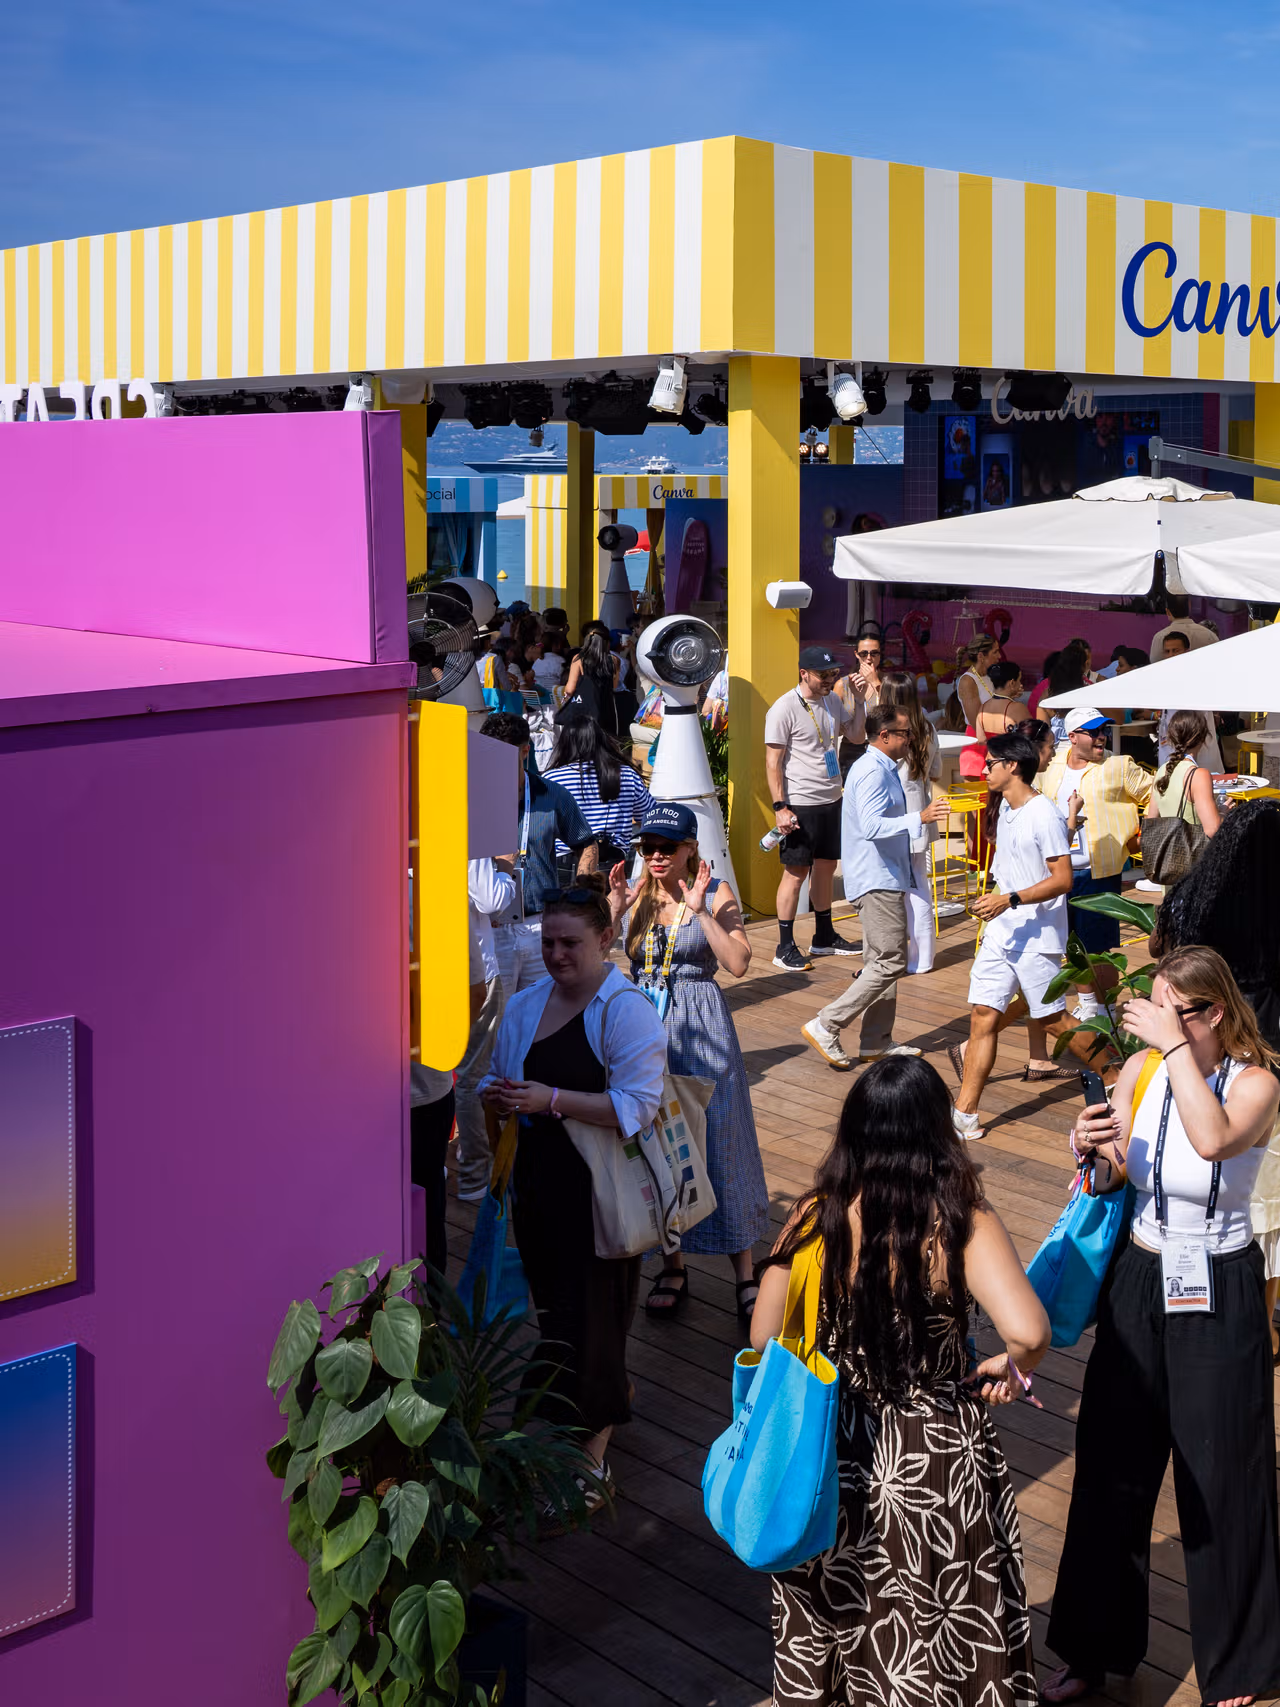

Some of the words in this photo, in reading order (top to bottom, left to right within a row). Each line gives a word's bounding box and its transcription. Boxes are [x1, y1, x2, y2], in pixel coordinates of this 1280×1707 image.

[653, 485, 694, 500] Canva
[646, 808, 661, 819] HOT
[662, 807, 679, 819] ROD
